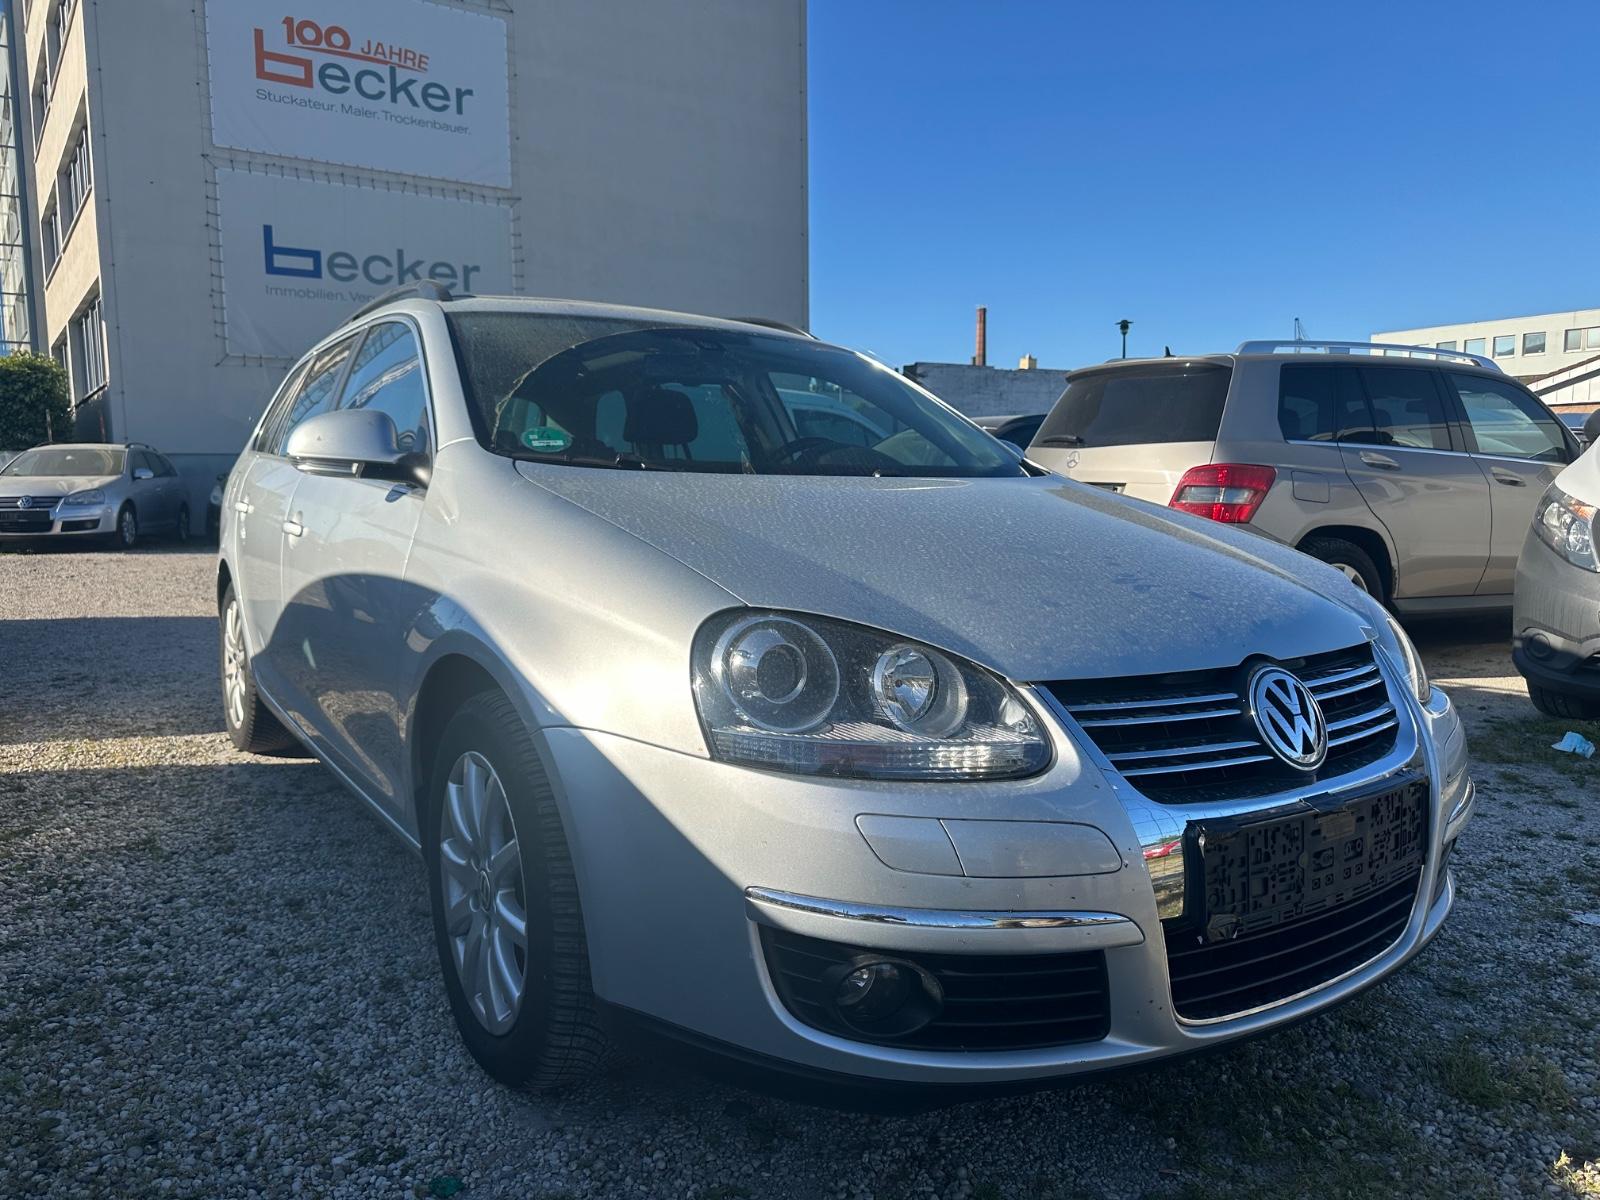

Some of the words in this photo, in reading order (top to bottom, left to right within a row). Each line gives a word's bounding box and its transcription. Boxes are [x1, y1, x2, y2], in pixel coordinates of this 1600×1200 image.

[254, 28, 474, 115] becker
[282, 16, 351, 50] 100
[361, 40, 429, 71] JAHRE
[257, 88, 338, 112] Stuckateur.
[382, 110, 472, 135] Trockenbauer.
[263, 224, 480, 292] becker
